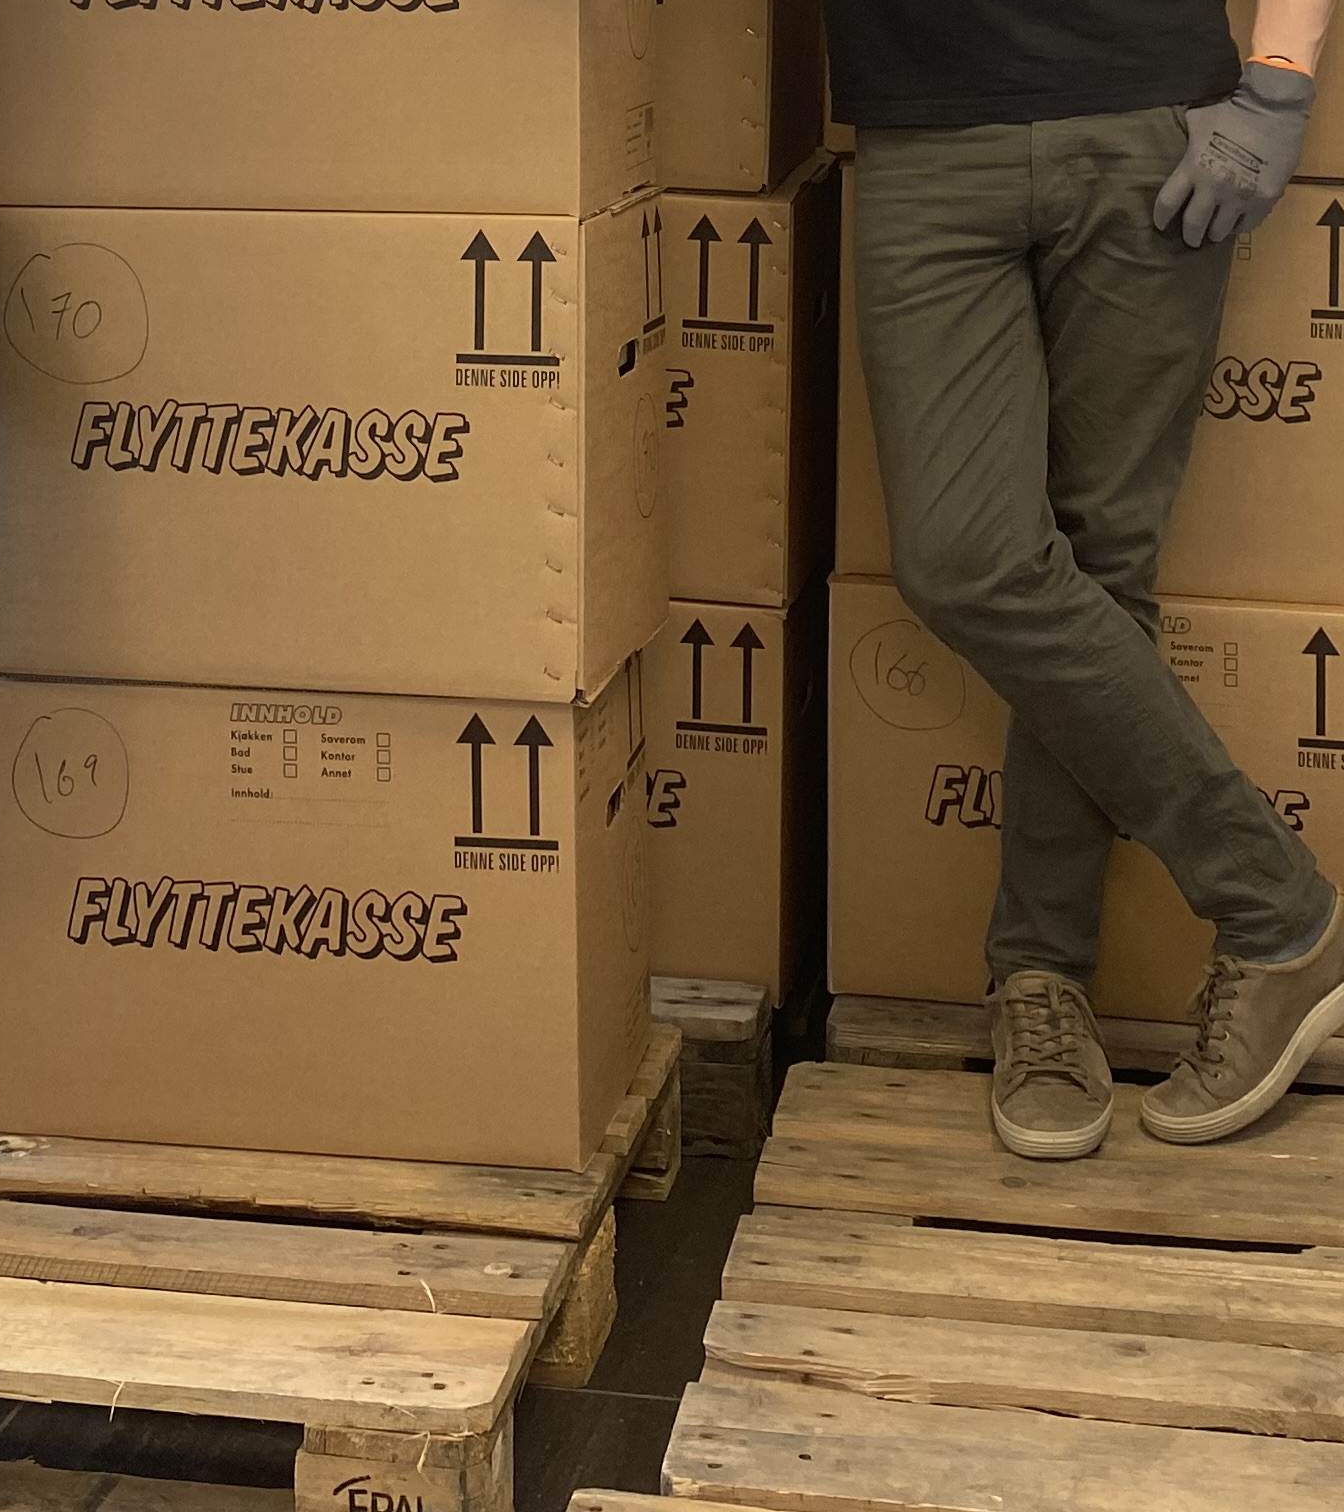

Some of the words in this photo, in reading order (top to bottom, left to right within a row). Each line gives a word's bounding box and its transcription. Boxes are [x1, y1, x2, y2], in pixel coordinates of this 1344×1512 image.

[21, 287, 102, 341] 170
[681, 331, 718, 349] DENNE
[721, 333, 746, 351] SIDE
[749, 335, 774, 353] OPP!
[456, 368, 496, 387] DENNE
[500, 369, 527, 388] SIDE
[532, 370, 560, 389] OPP!
[71, 399, 470, 482] FLYTTEKASSE
[1170, 641, 1214, 653] Soverom
[1170, 656, 1204, 668] Kontor
[230, 703, 343, 726] INNHOLD
[230, 730, 273, 743] Kjøkken
[320, 733, 366, 745] Soverom
[675, 733, 710, 751] DENNE
[714, 735, 738, 753] SIDE
[742, 737, 768, 755] OPP!
[230, 747, 251, 758] Bad
[320, 750, 355, 761] Kontor
[1298, 751, 1337, 770] DENNE
[35, 752, 98, 803] 169
[231, 764, 253, 774] Stue
[320, 767, 352, 778] Annet
[454, 851, 495, 872] DENNE
[499, 852, 526, 872] SIDE
[531, 854, 559, 873] OPP!
[67, 876, 468, 963] FLYTTEKASSE
